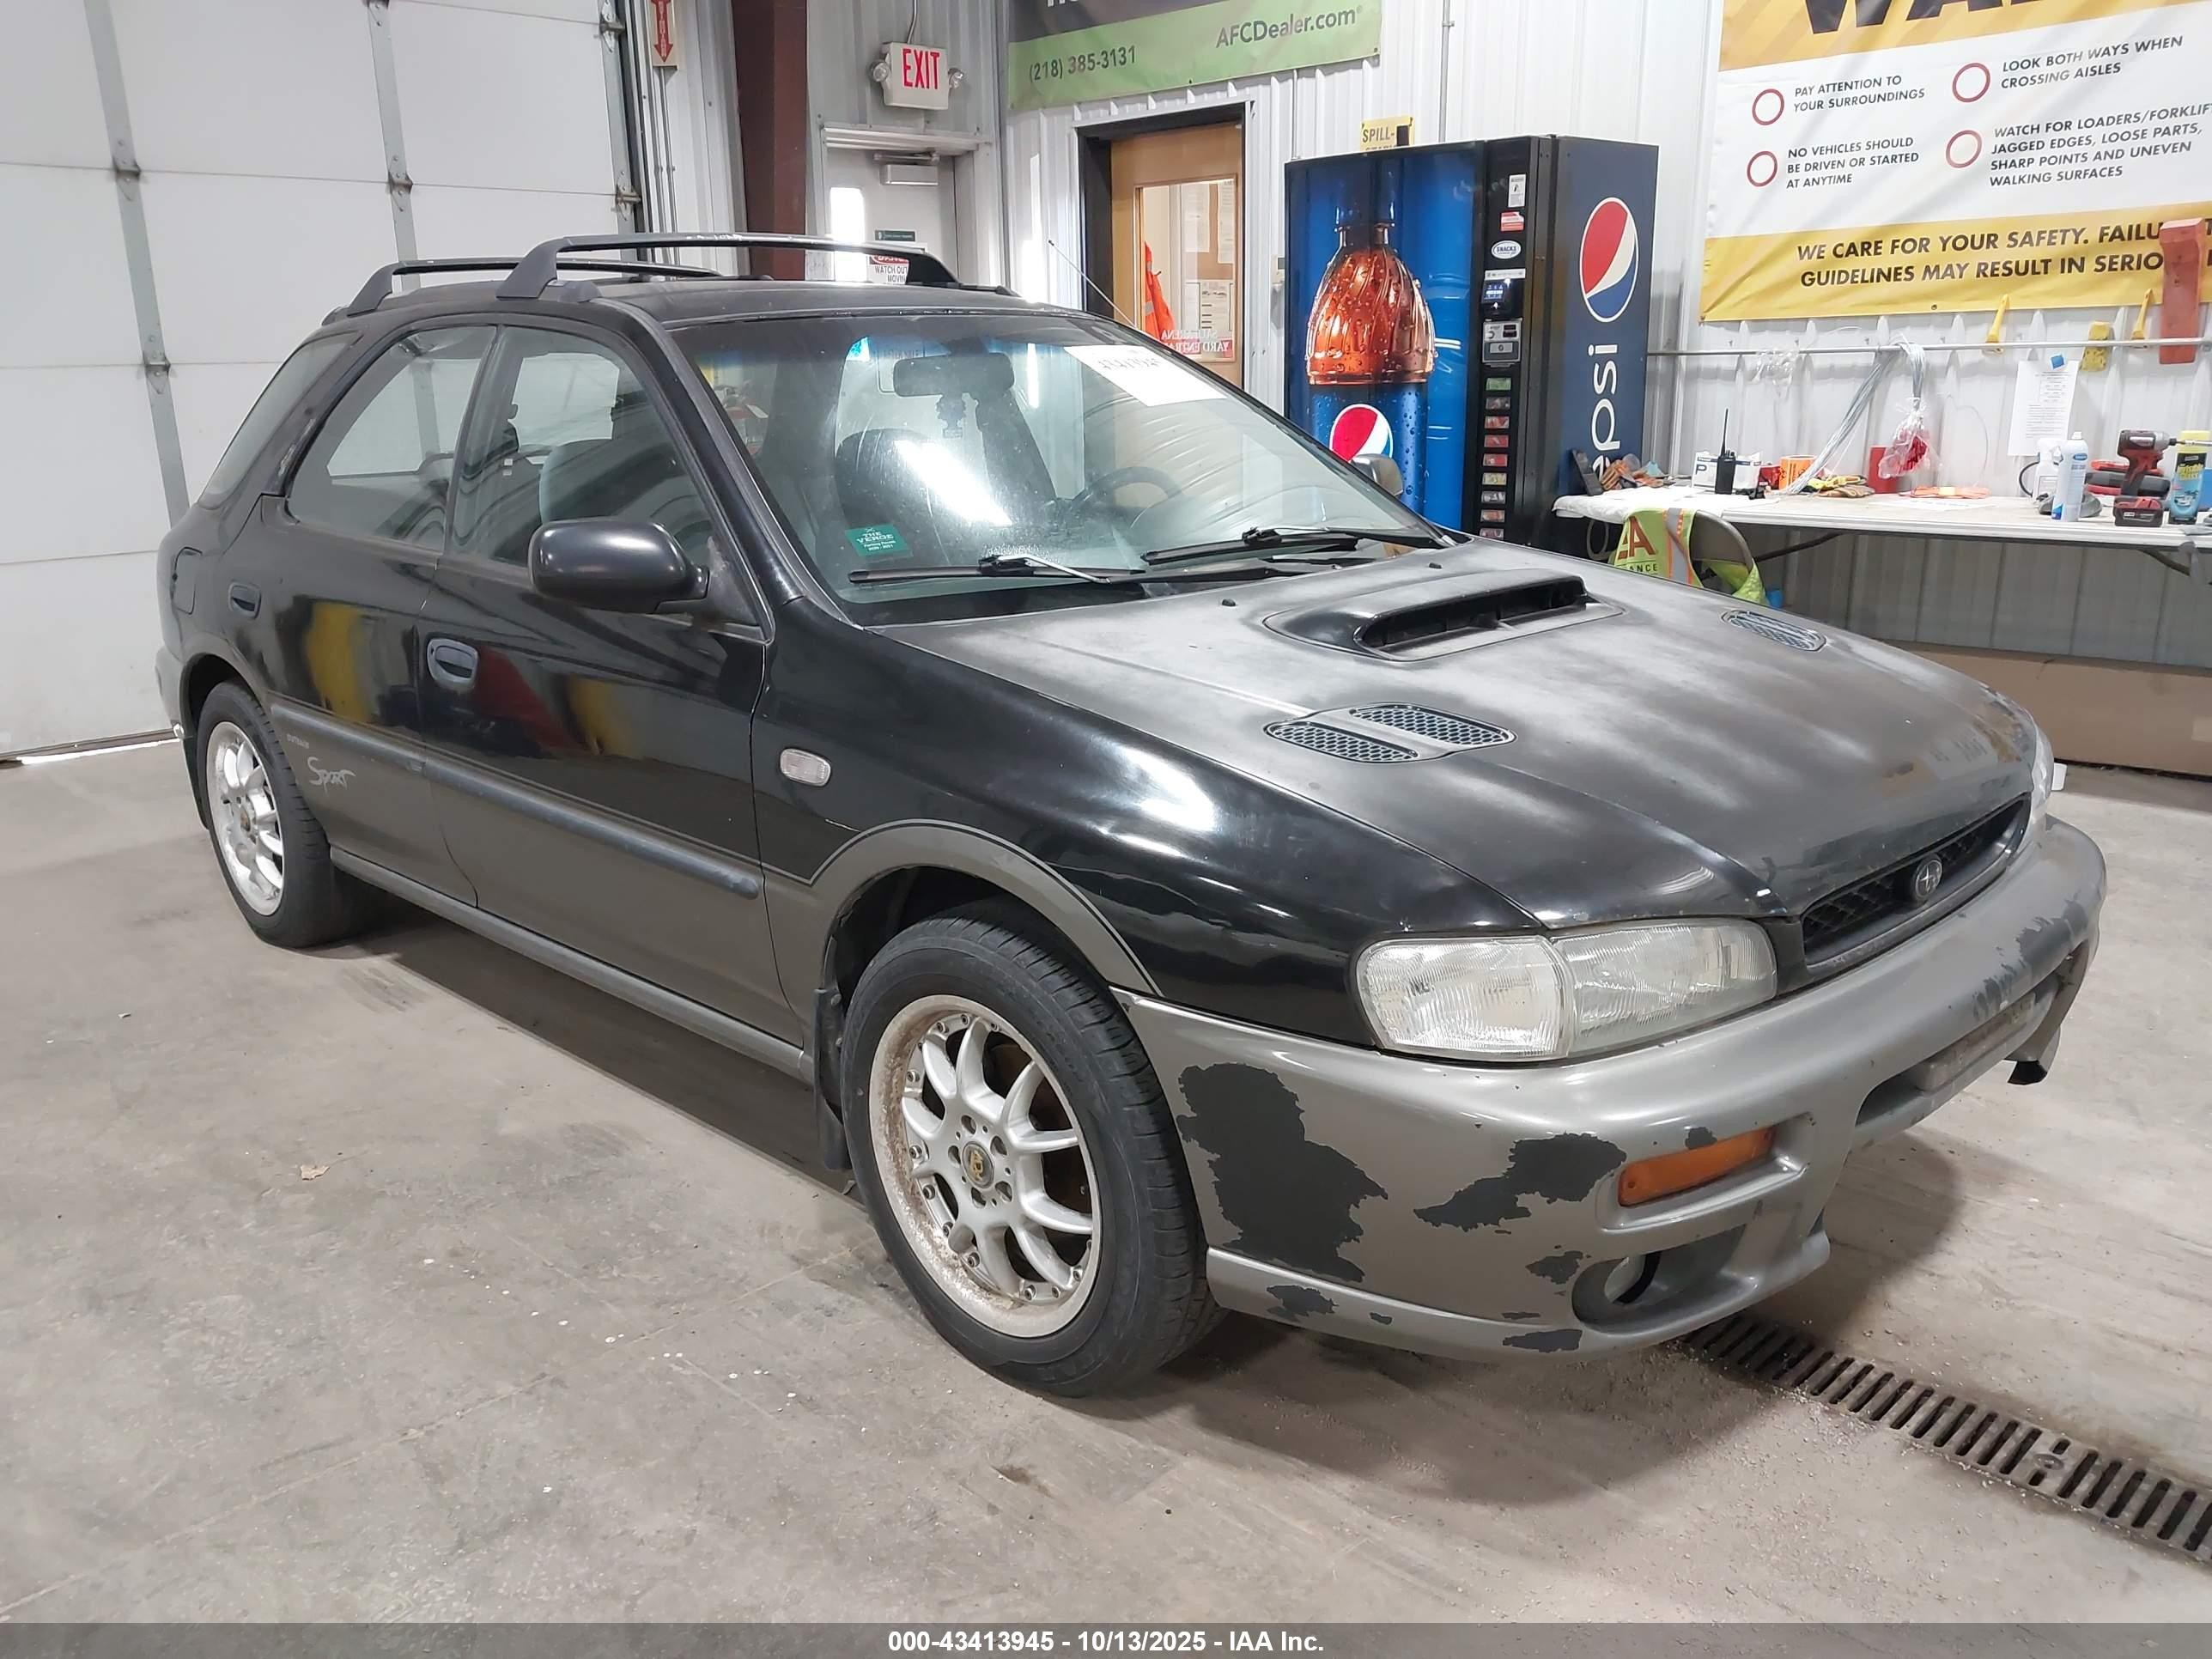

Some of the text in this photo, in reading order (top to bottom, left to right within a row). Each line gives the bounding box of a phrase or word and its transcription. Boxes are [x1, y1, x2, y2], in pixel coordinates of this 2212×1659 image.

[1030, 46, 1135, 82] (218) 385-3131
[2002, 35, 2184, 72] LOOK BOTH WAYS WHEN
[902, 48, 939, 89] EXIT
[2001, 62, 2121, 88] CROSSING AISLES
[1795, 75, 1902, 97] PAY ATTENTION TO
[1794, 88, 1925, 112] YOUR SURROUNDINGS
[1362, 126, 1395, 143] SPILL-
[1991, 122, 2203, 155] JAGGED EDGES, LOOSE PARTS,
[1994, 124, 2040, 138] WATCH
[2045, 120, 2073, 134] FOR
[1788, 137, 1914, 159] NO VEHICLES SHOULD
[1990, 141, 2192, 171] SHARP POINTS AND UNEVEN
[1787, 152, 1919, 173] BE DRIVEN OR STARTED
[1786, 173, 1853, 189] AT ANYTIME
[1990, 166, 2124, 186] WALKING SURFACES
[1797, 244, 1827, 261] WE
[1832, 240, 1883, 259] CARE
[1890, 236, 1931, 255] FOR
[1938, 233, 1999, 252] YOUR
[2006, 227, 2089, 249] SAFETY.
[875, 265, 896, 274] WATCH
[1801, 264, 1915, 287] GUIDELINES
[1921, 262, 1970, 281] MAY
[1975, 258, 2052, 278] RESULT
[2061, 257, 2086, 275] IN
